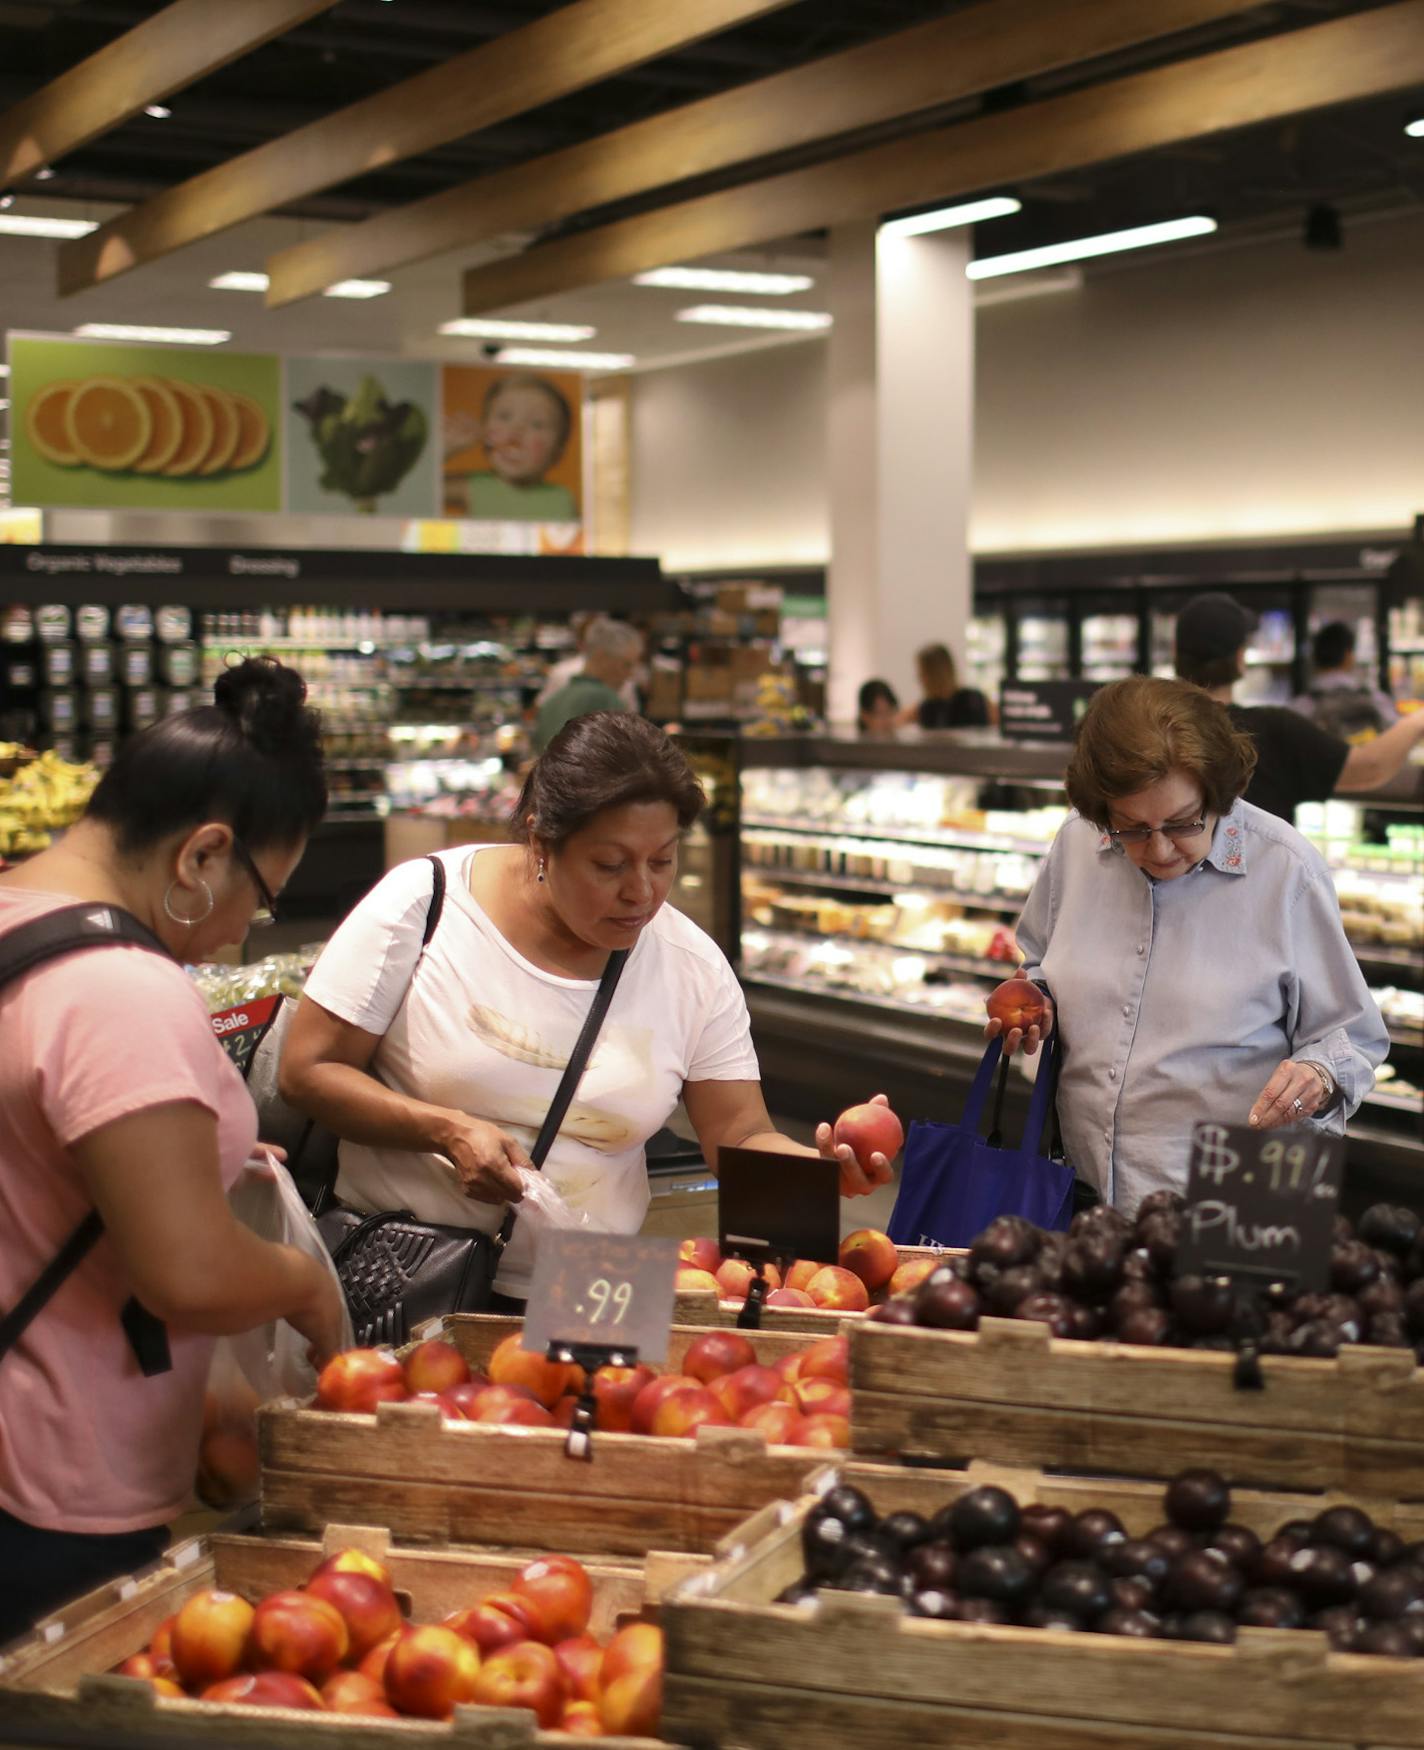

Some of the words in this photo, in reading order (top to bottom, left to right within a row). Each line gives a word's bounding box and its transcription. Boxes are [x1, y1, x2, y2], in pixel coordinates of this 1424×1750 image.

[27, 552, 90, 574] Organic
[94, 554, 182, 575] Vegetables
[212, 1013, 248, 1034] Sale
[1186, 1200, 1300, 1250] Plum
[575, 1279, 632, 1325] .99
